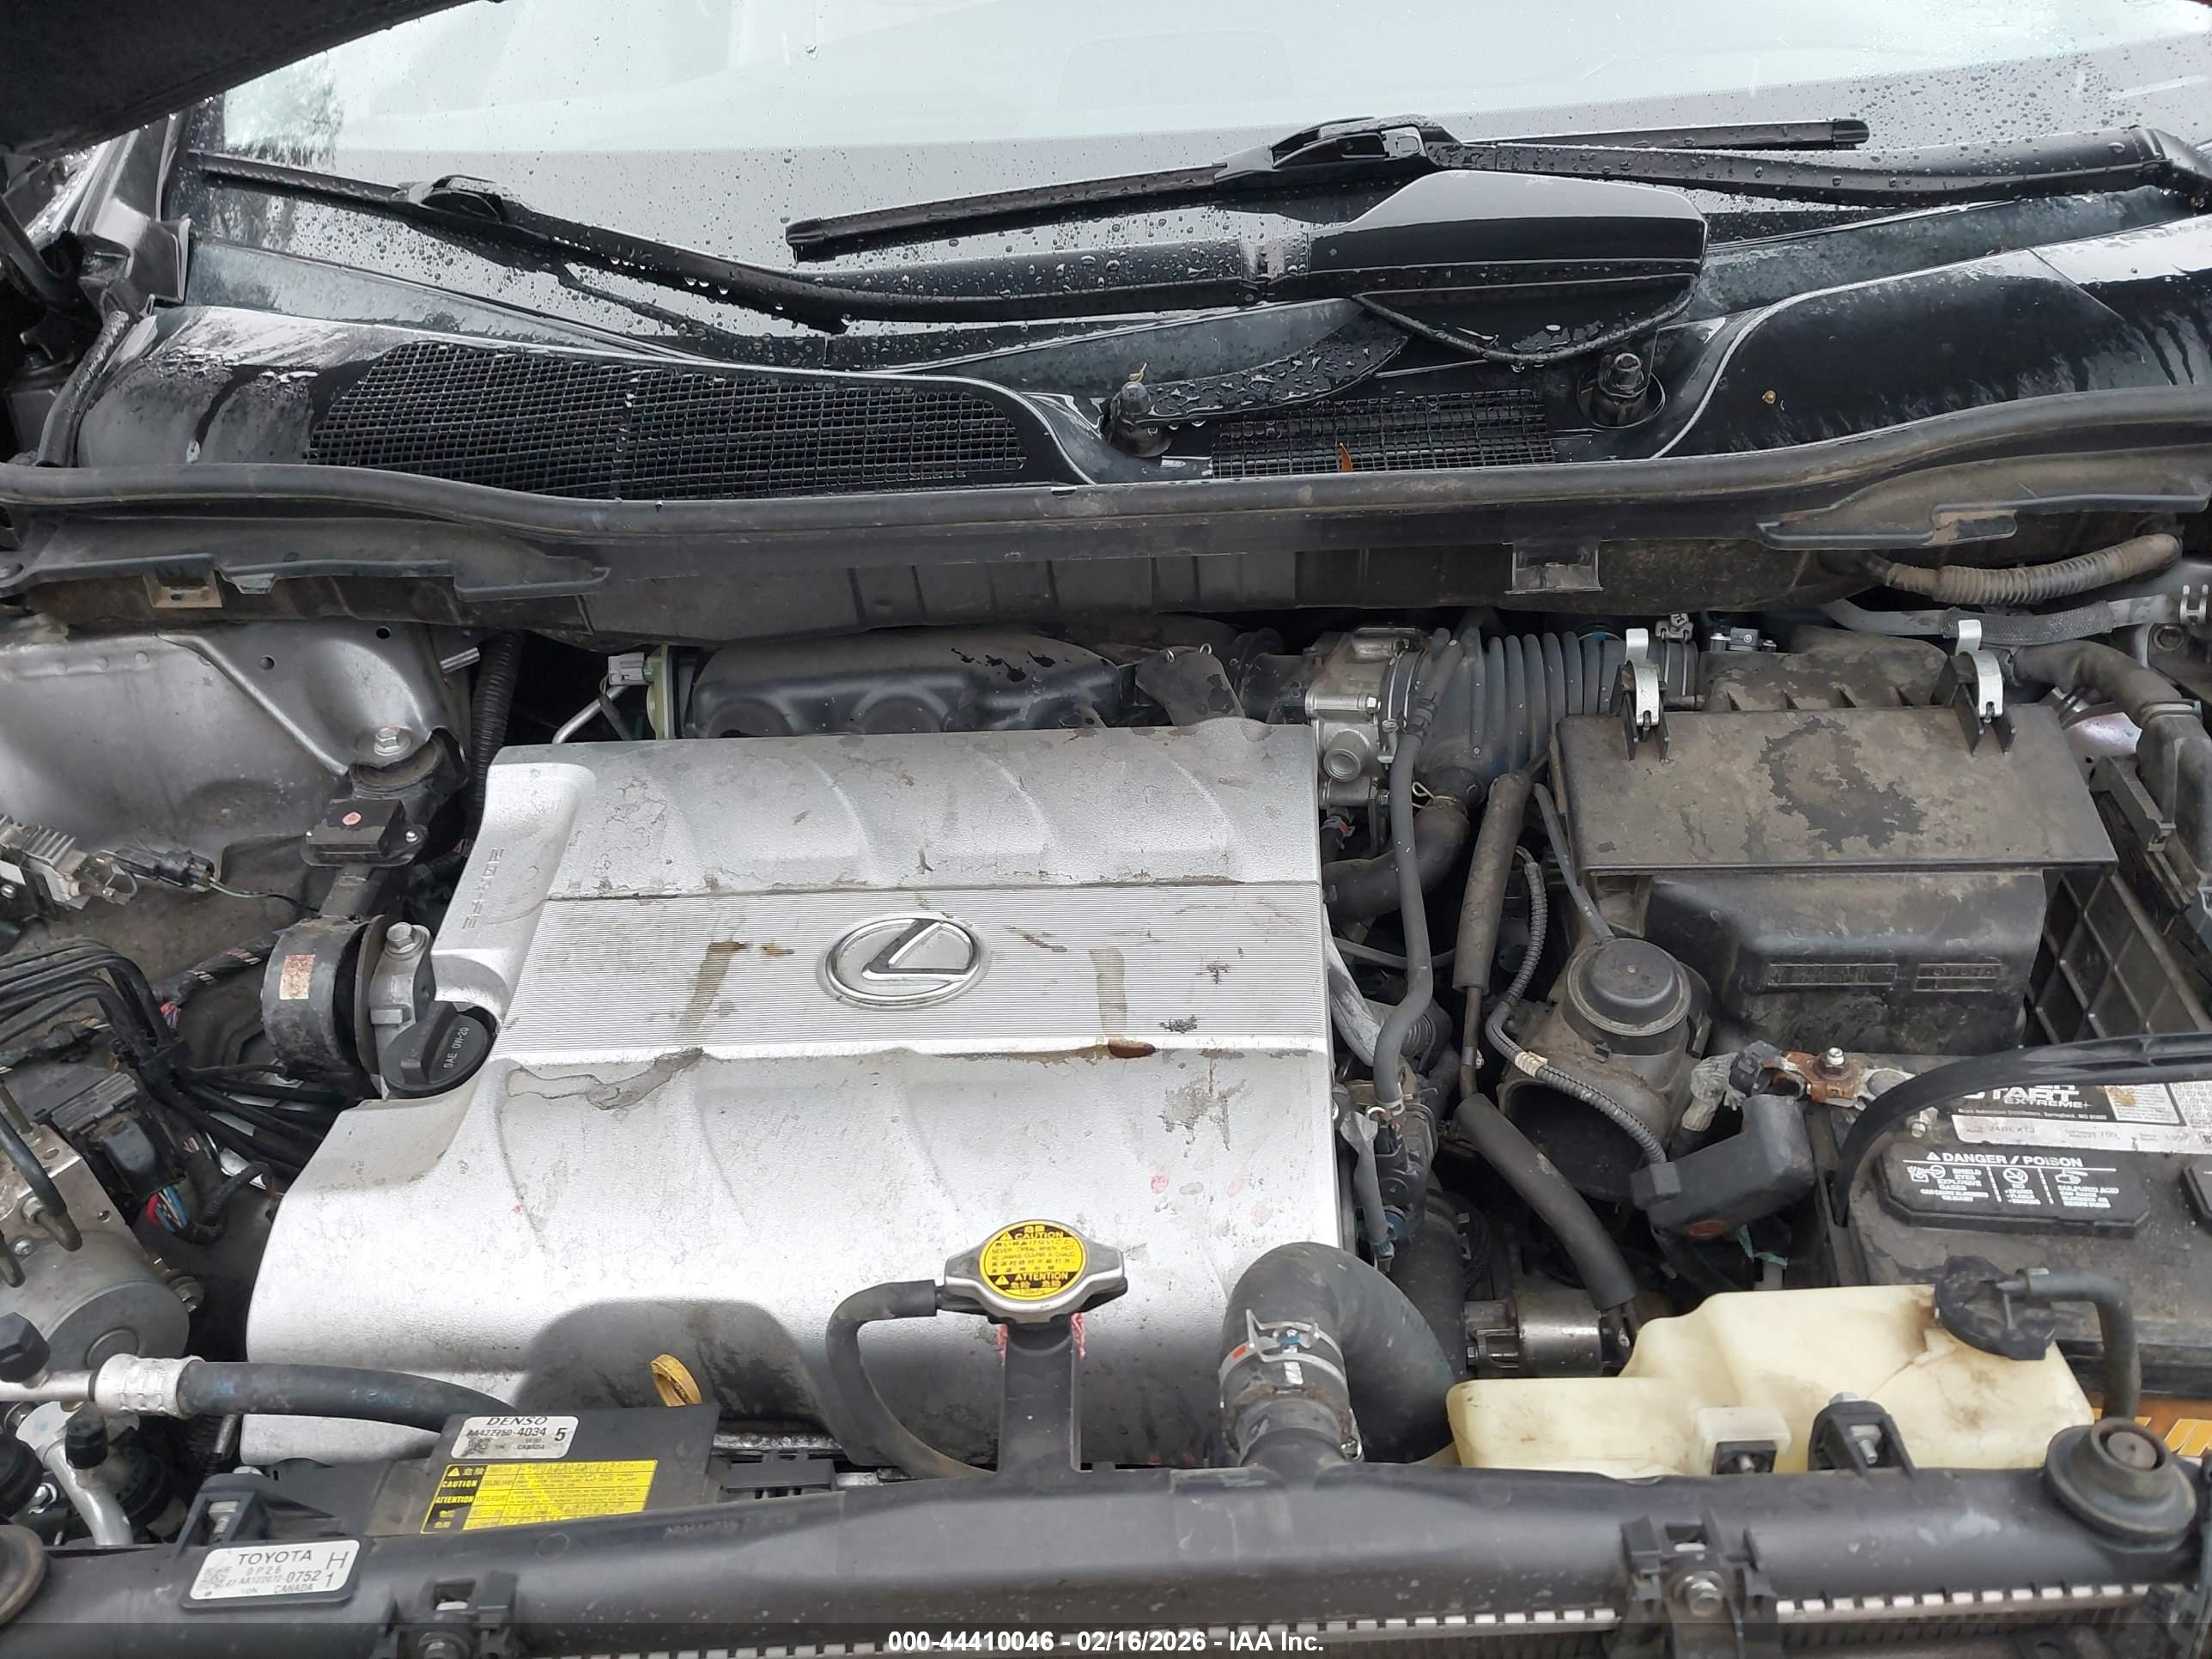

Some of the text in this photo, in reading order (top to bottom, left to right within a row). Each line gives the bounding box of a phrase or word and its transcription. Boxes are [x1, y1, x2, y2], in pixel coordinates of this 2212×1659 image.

[443, 1052, 458, 1068] SAE
[1942, 1152, 2008, 1164] DANGER
[2023, 1157, 2083, 1168] POISON
[1014, 1231, 1064, 1240] CAUTION
[1014, 1272, 1069, 1282] ATTENTION
[486, 1416, 548, 1426] DENSO
[554, 1427, 568, 1442] 5
[441, 1480, 478, 1488] CAUTION
[434, 1495, 475, 1504] ATTENTION
[238, 1549, 349, 1571] TOYOTA H
[321, 1574, 335, 1588] 1
[274, 1583, 313, 1595] CANADA
